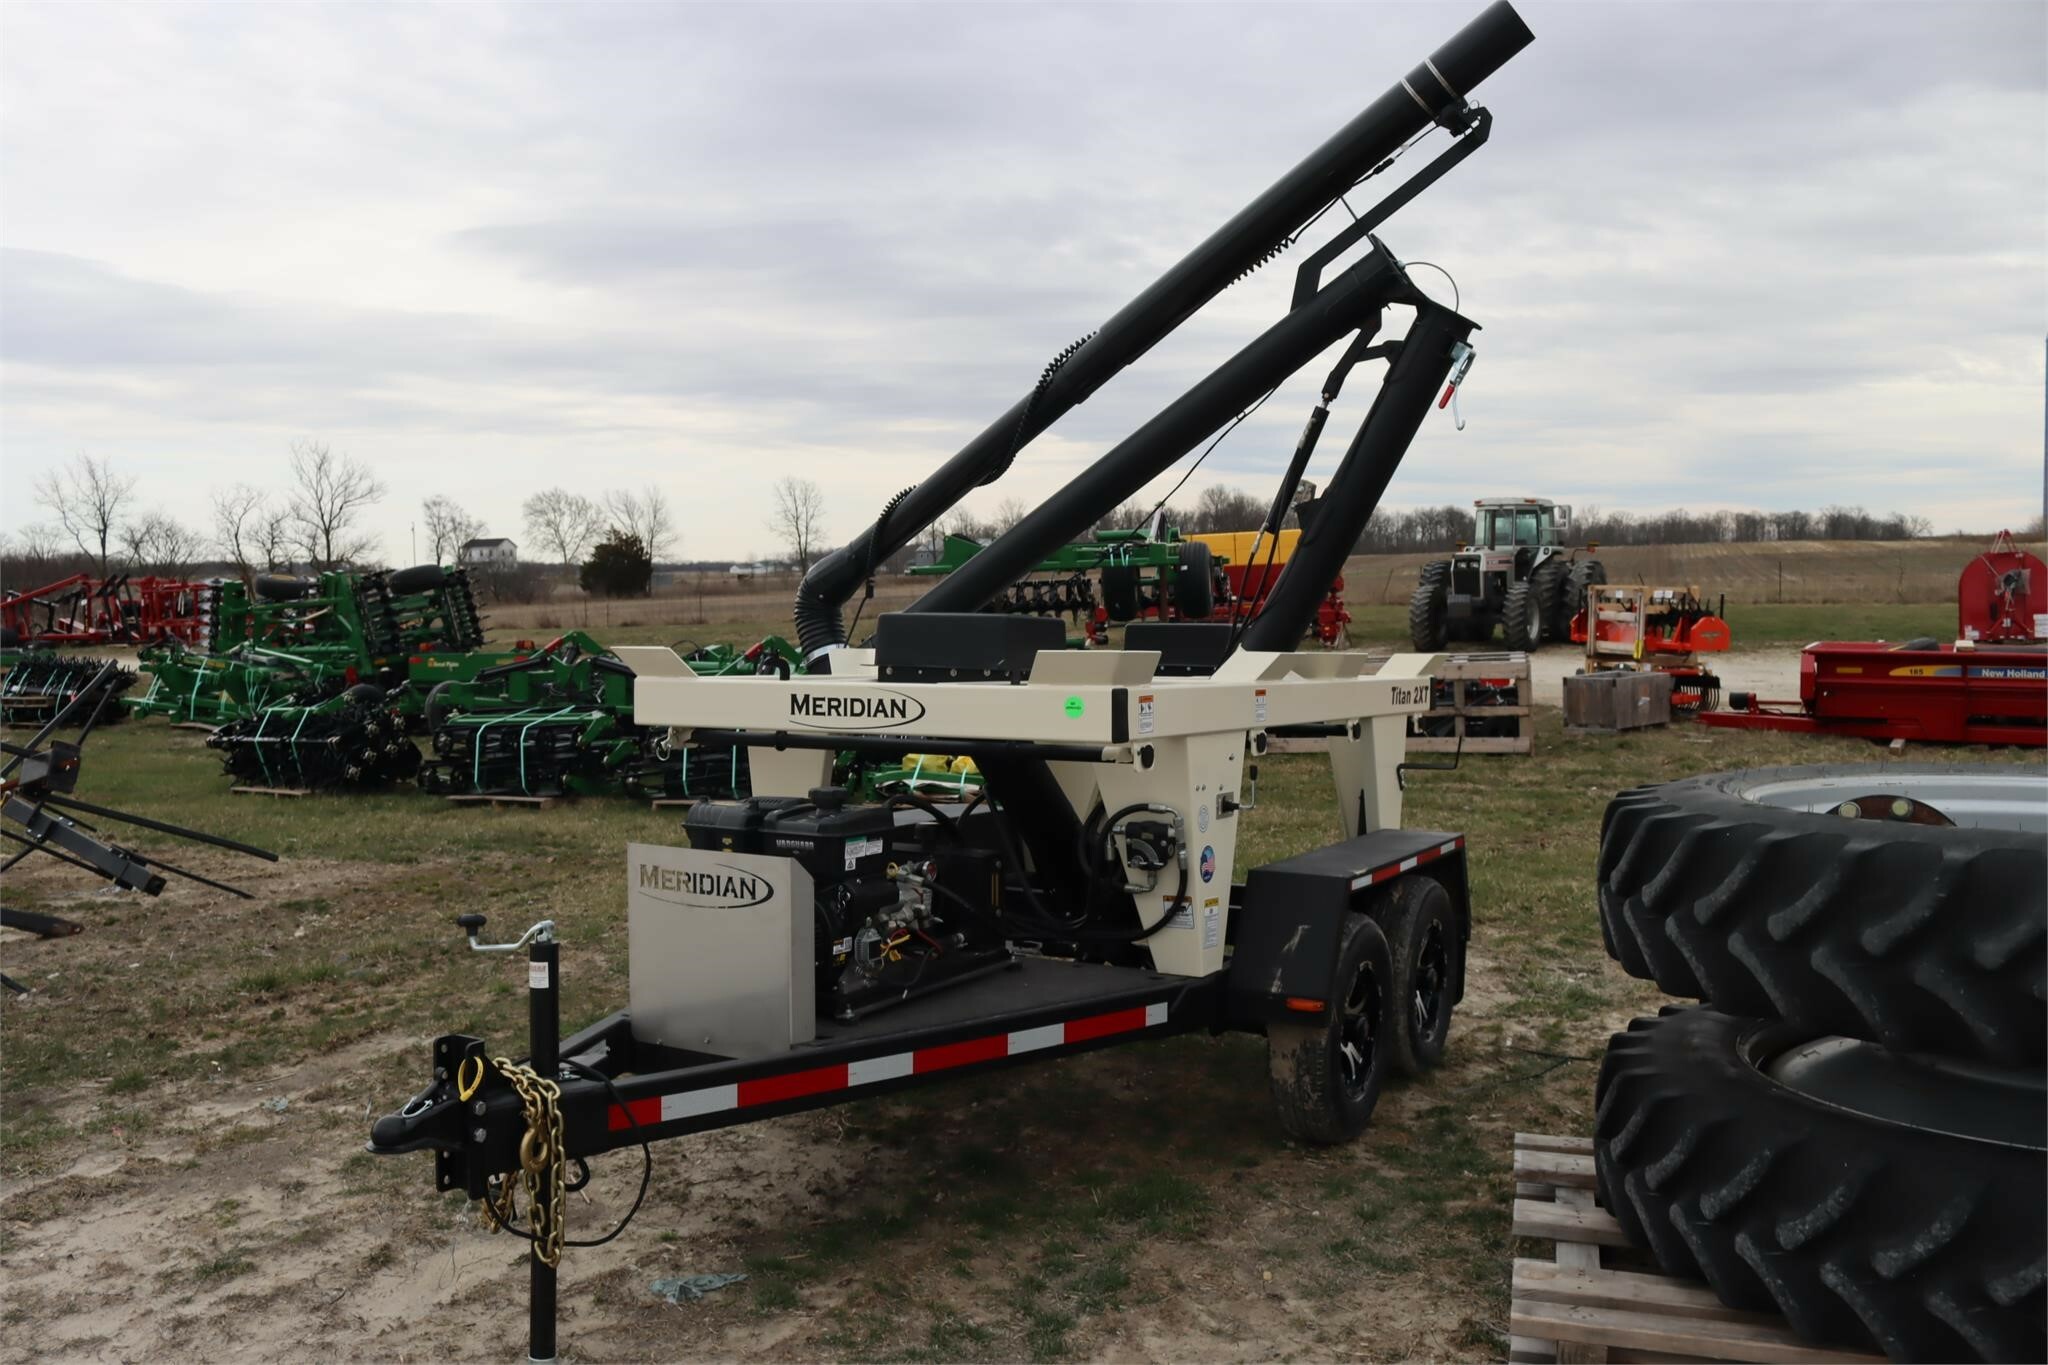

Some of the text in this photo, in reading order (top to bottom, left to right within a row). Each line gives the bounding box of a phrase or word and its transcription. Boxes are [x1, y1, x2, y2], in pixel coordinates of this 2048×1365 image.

[1982, 668, 2046, 679] New Holland
[790, 693, 907, 718] MERIDIAN
[1391, 685, 1429, 705] Titan 2XT
[639, 864, 756, 900] MERIDIAN
